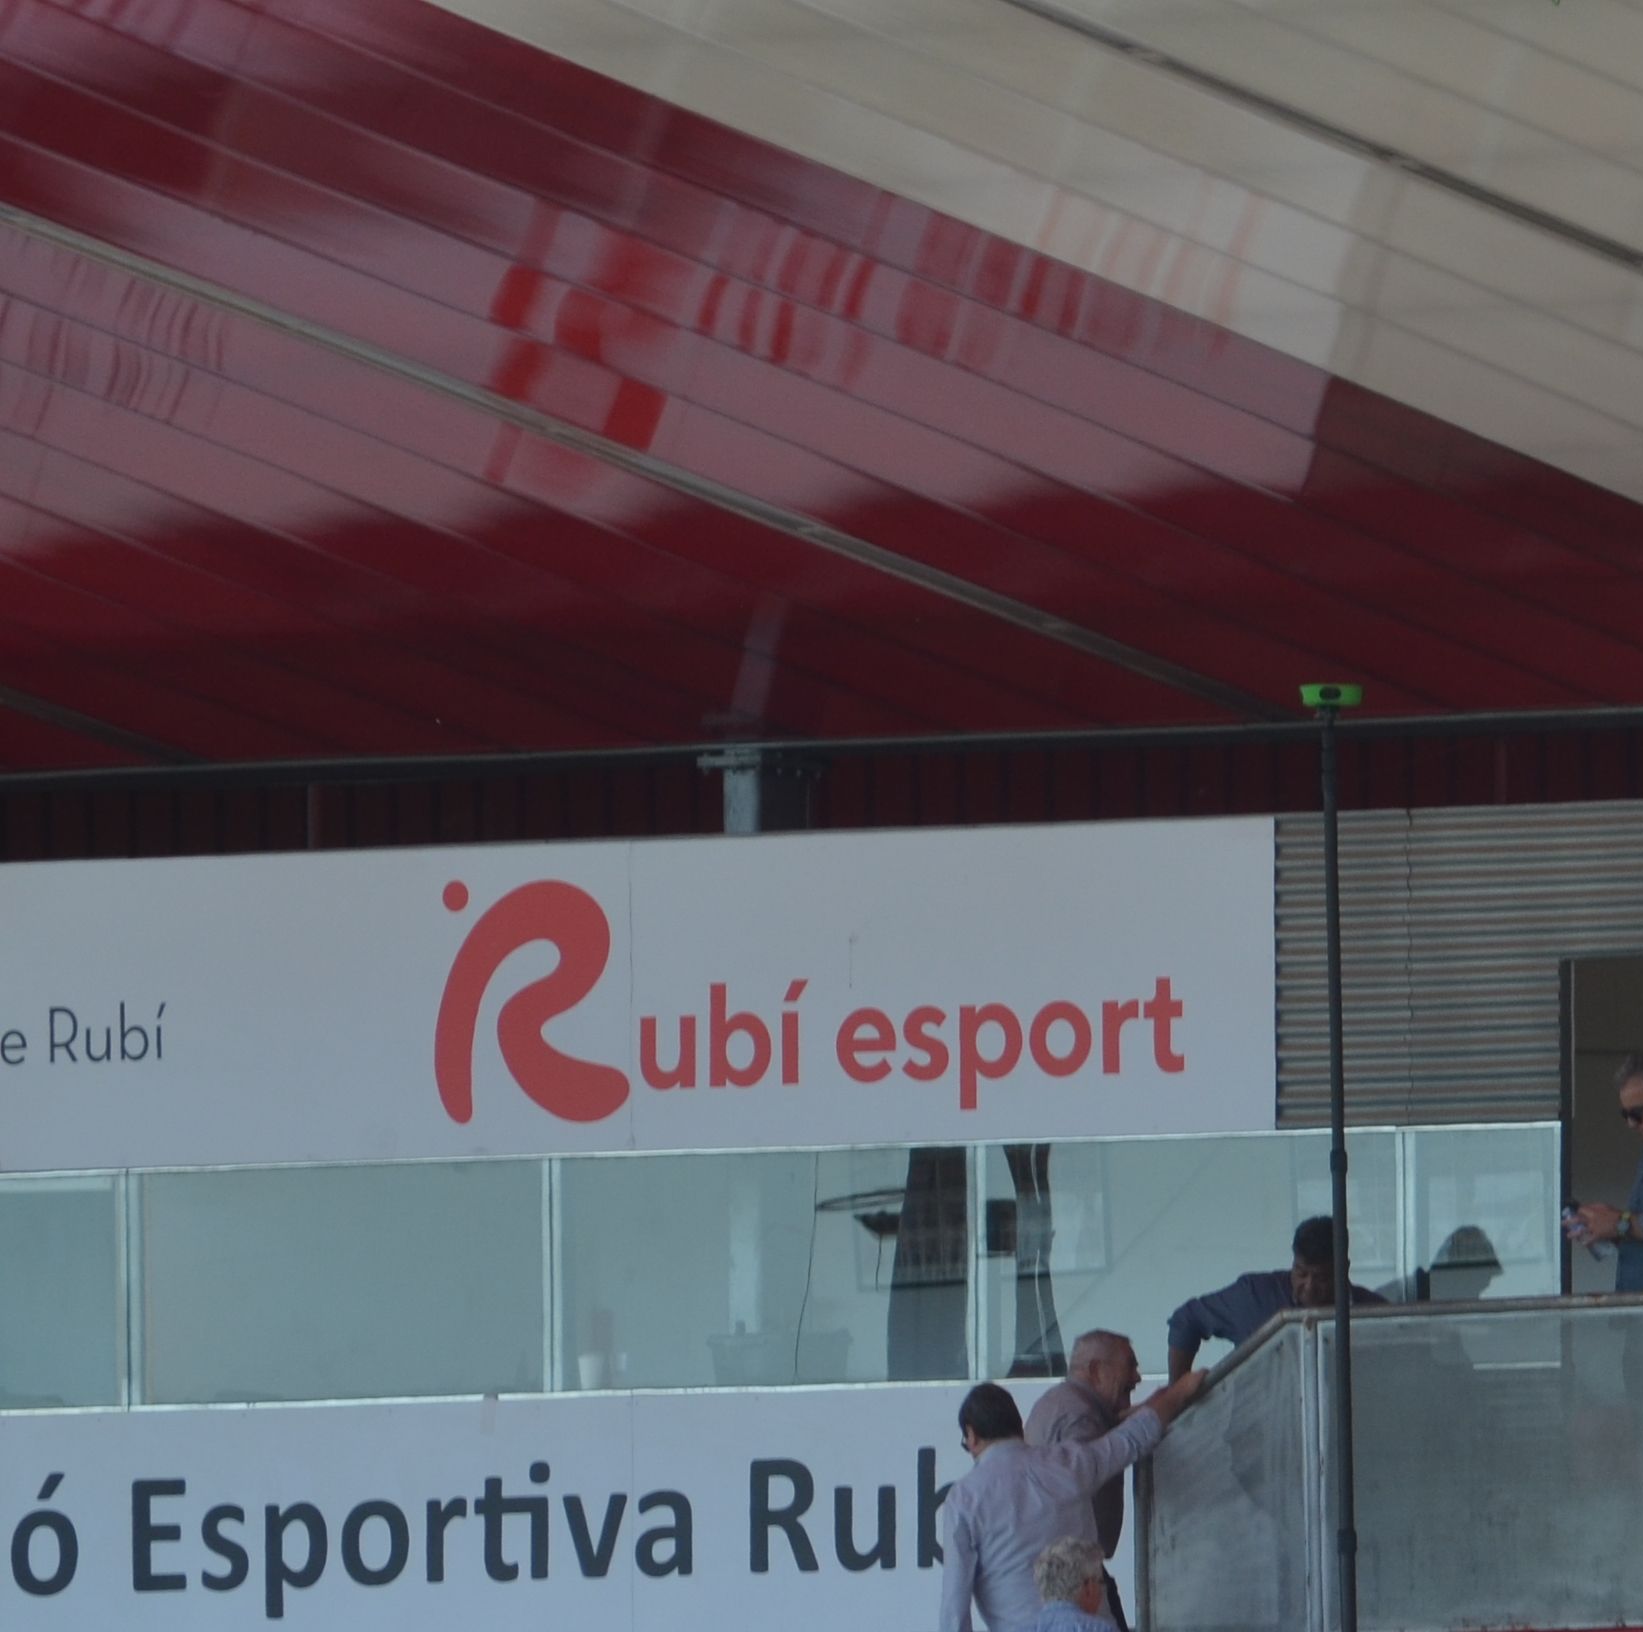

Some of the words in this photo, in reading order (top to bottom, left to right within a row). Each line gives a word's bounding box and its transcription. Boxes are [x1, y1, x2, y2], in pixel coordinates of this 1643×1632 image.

[48, 1000, 166, 1064] Rubí
[434, 878, 809, 1127] Rubí
[835, 975, 1186, 1113] esport
[131, 1461, 694, 1620] Esportiva
